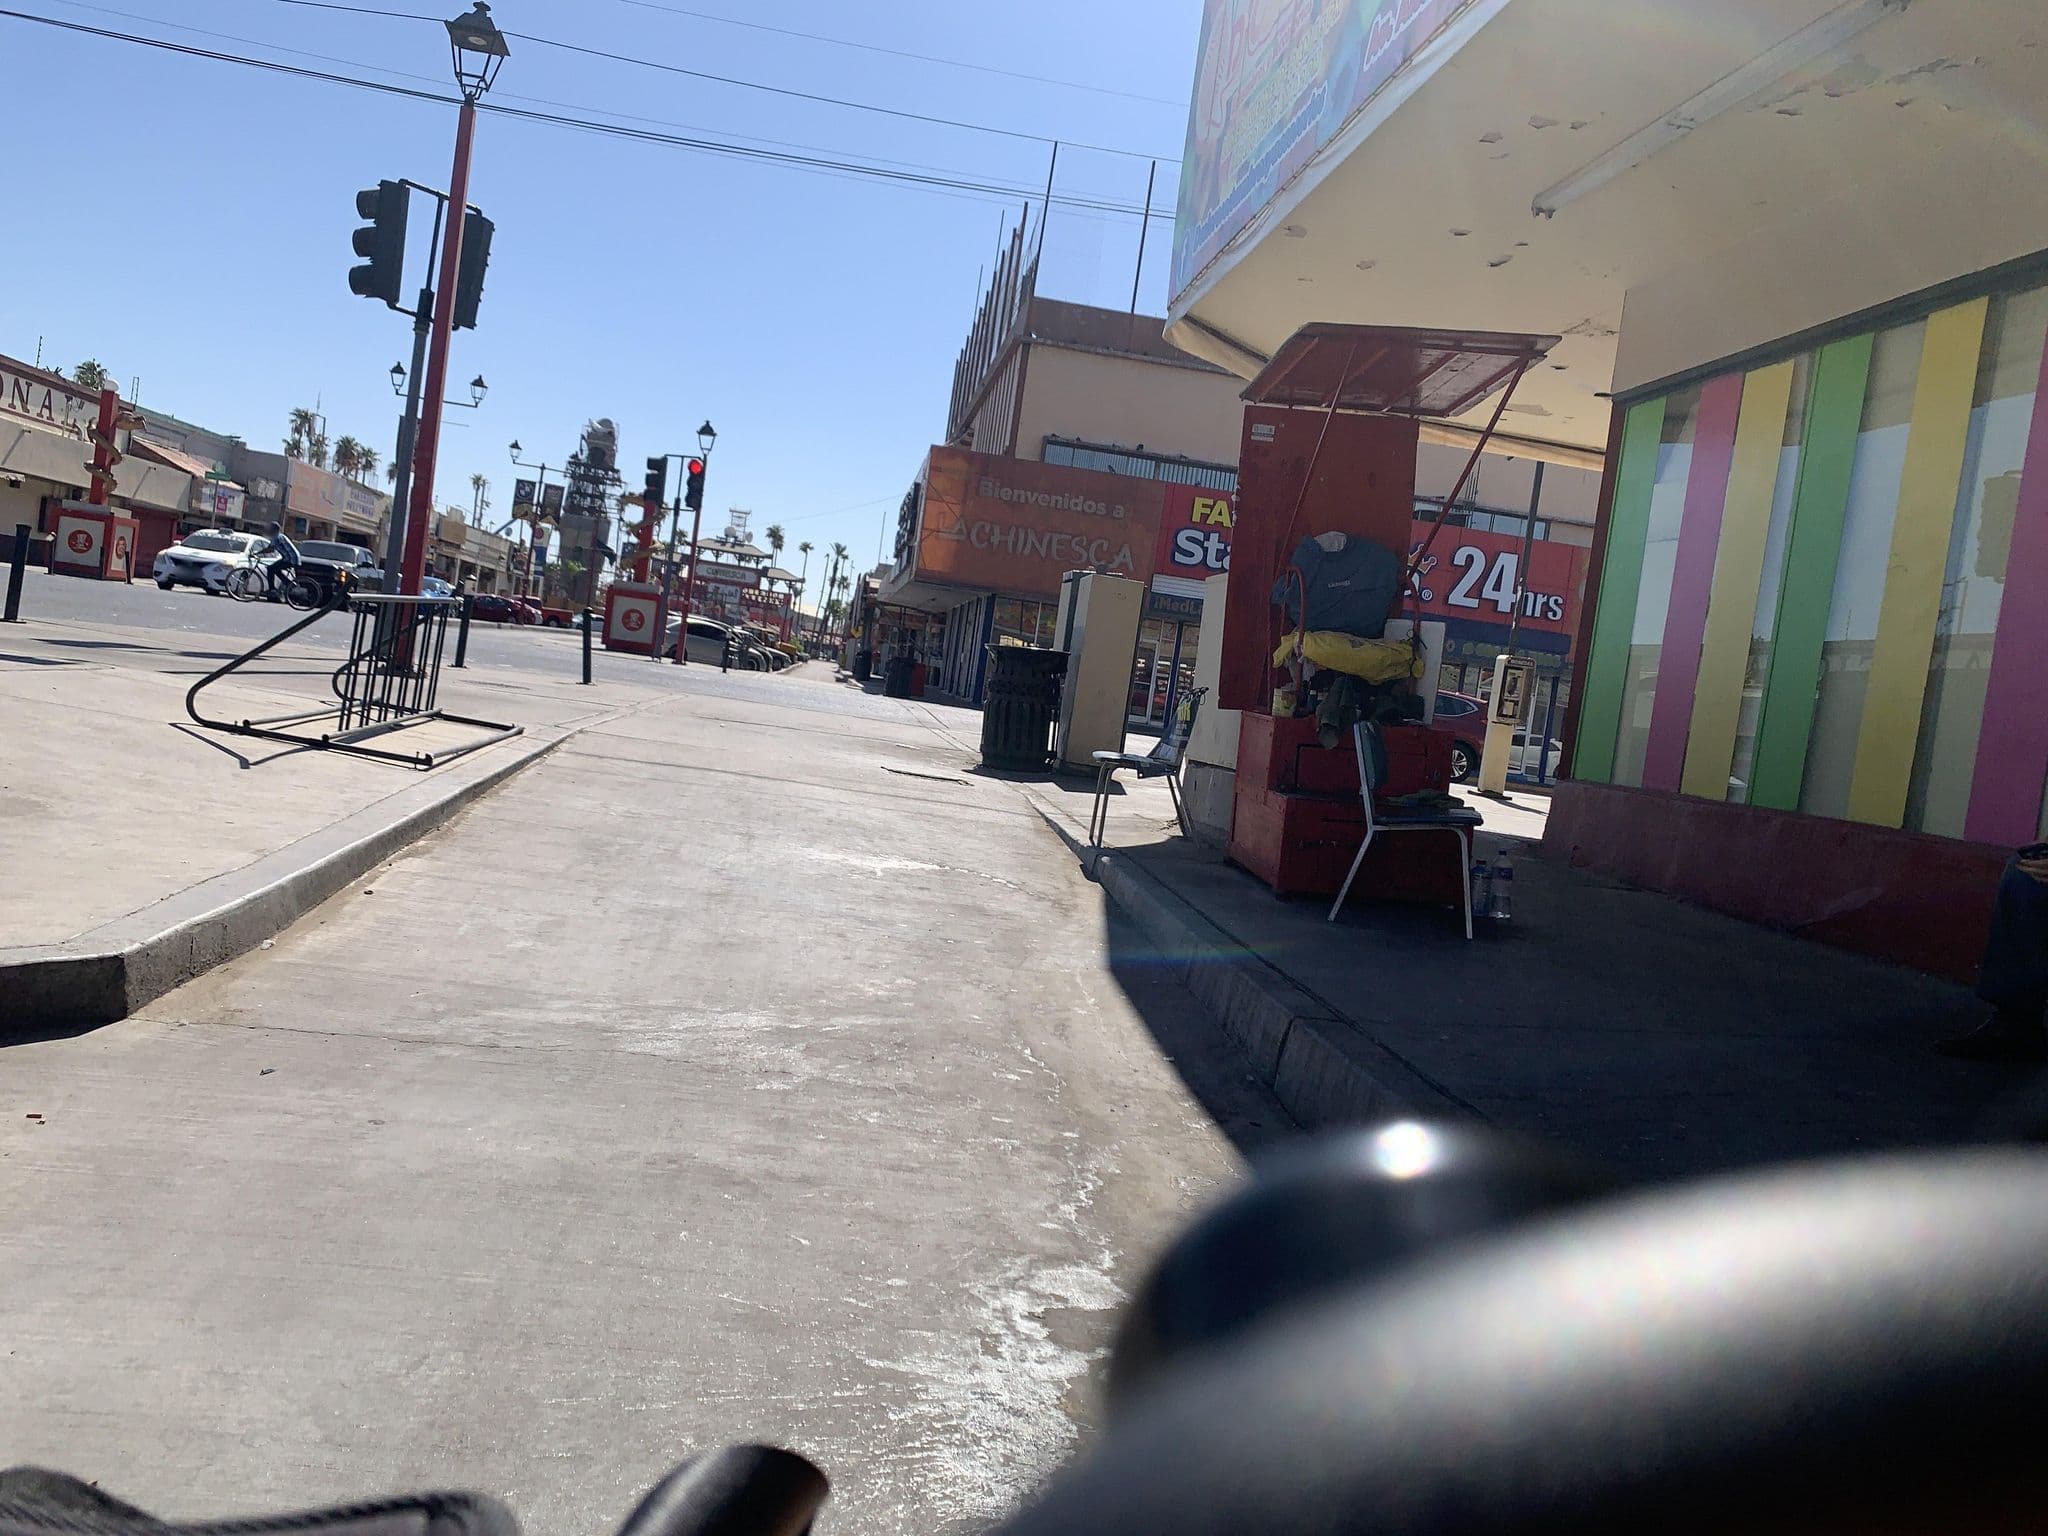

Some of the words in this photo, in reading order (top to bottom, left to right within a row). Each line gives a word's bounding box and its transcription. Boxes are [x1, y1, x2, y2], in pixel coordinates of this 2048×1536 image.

[979, 479, 1107, 516] Bienvenidos
[1112, 504, 1125, 519] a
[969, 520, 1135, 572] CHINESCA
